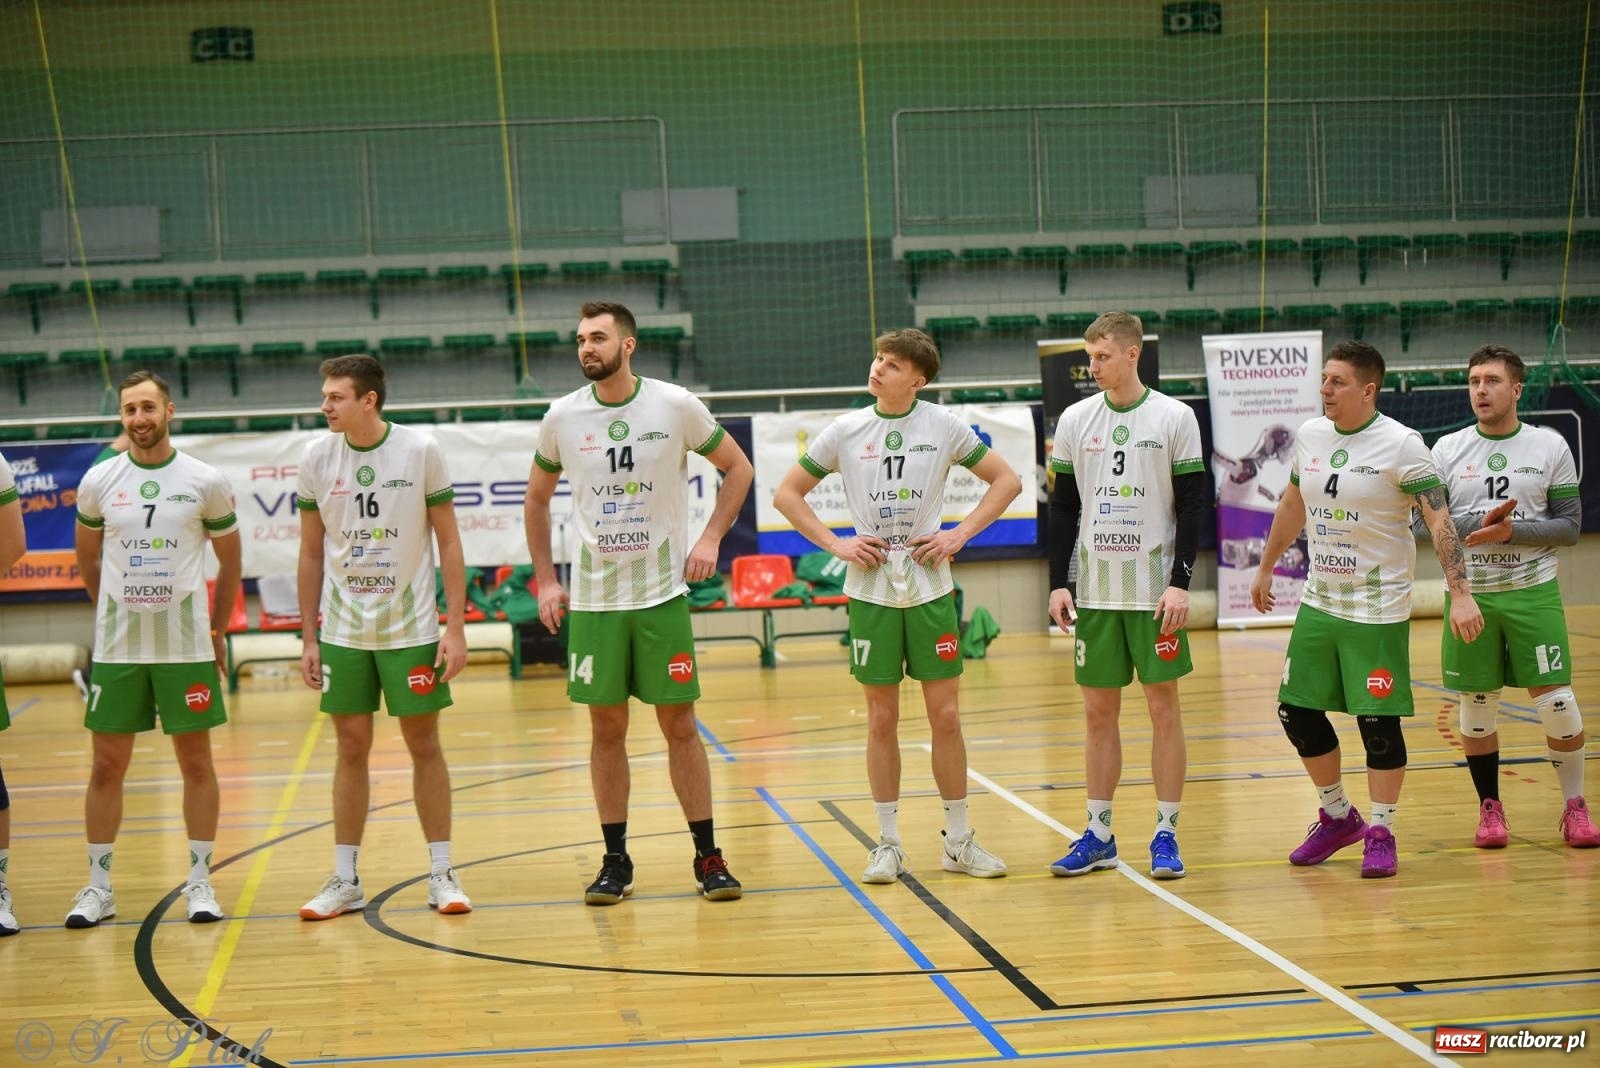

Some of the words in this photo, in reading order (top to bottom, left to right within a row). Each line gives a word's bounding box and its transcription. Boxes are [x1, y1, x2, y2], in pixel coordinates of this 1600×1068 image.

[1220, 347, 1308, 367] PIVEXIN
[1221, 367, 1308, 380] TECHNOLOGY
[606, 446, 635, 474] 14
[883, 455, 905, 480] 17
[1112, 450, 1126, 476] 3
[591, 481, 653, 496] VISON
[1094, 485, 1145, 497] VISON
[1324, 473, 1339, 499] 4
[1484, 476, 1510, 500] 12
[869, 488, 923, 503] VISON
[355, 492, 380, 518] 16
[143, 505, 156, 529] 7
[1309, 505, 1359, 521] VISON
[342, 527, 398, 540] VISON
[597, 531, 649, 545] PIVEXIN
[1094, 533, 1141, 545] PIVEXIN
[121, 537, 178, 550] VISON
[598, 543, 650, 553] TECHNOLOGY
[1095, 544, 1140, 552] TECHNOLOGY
[1315, 553, 1356, 567] PIVEXIN
[1472, 553, 1521, 564] PIVEXIN
[4, 562, 80, 580] ciborz.p
[1314, 564, 1356, 574] TECHNOLOGY
[347, 576, 396, 587] PIVEXIN
[124, 585, 173, 596] PIVEXIN
[349, 586, 396, 594] TECHNOLOGY
[852, 638, 872, 667] 17
[1075, 639, 1086, 667] 3
[1535, 644, 1564, 675] 12
[569, 652, 594, 685] 14
[1366, 675, 1394, 690] RV
[91, 684, 102, 712] 7
